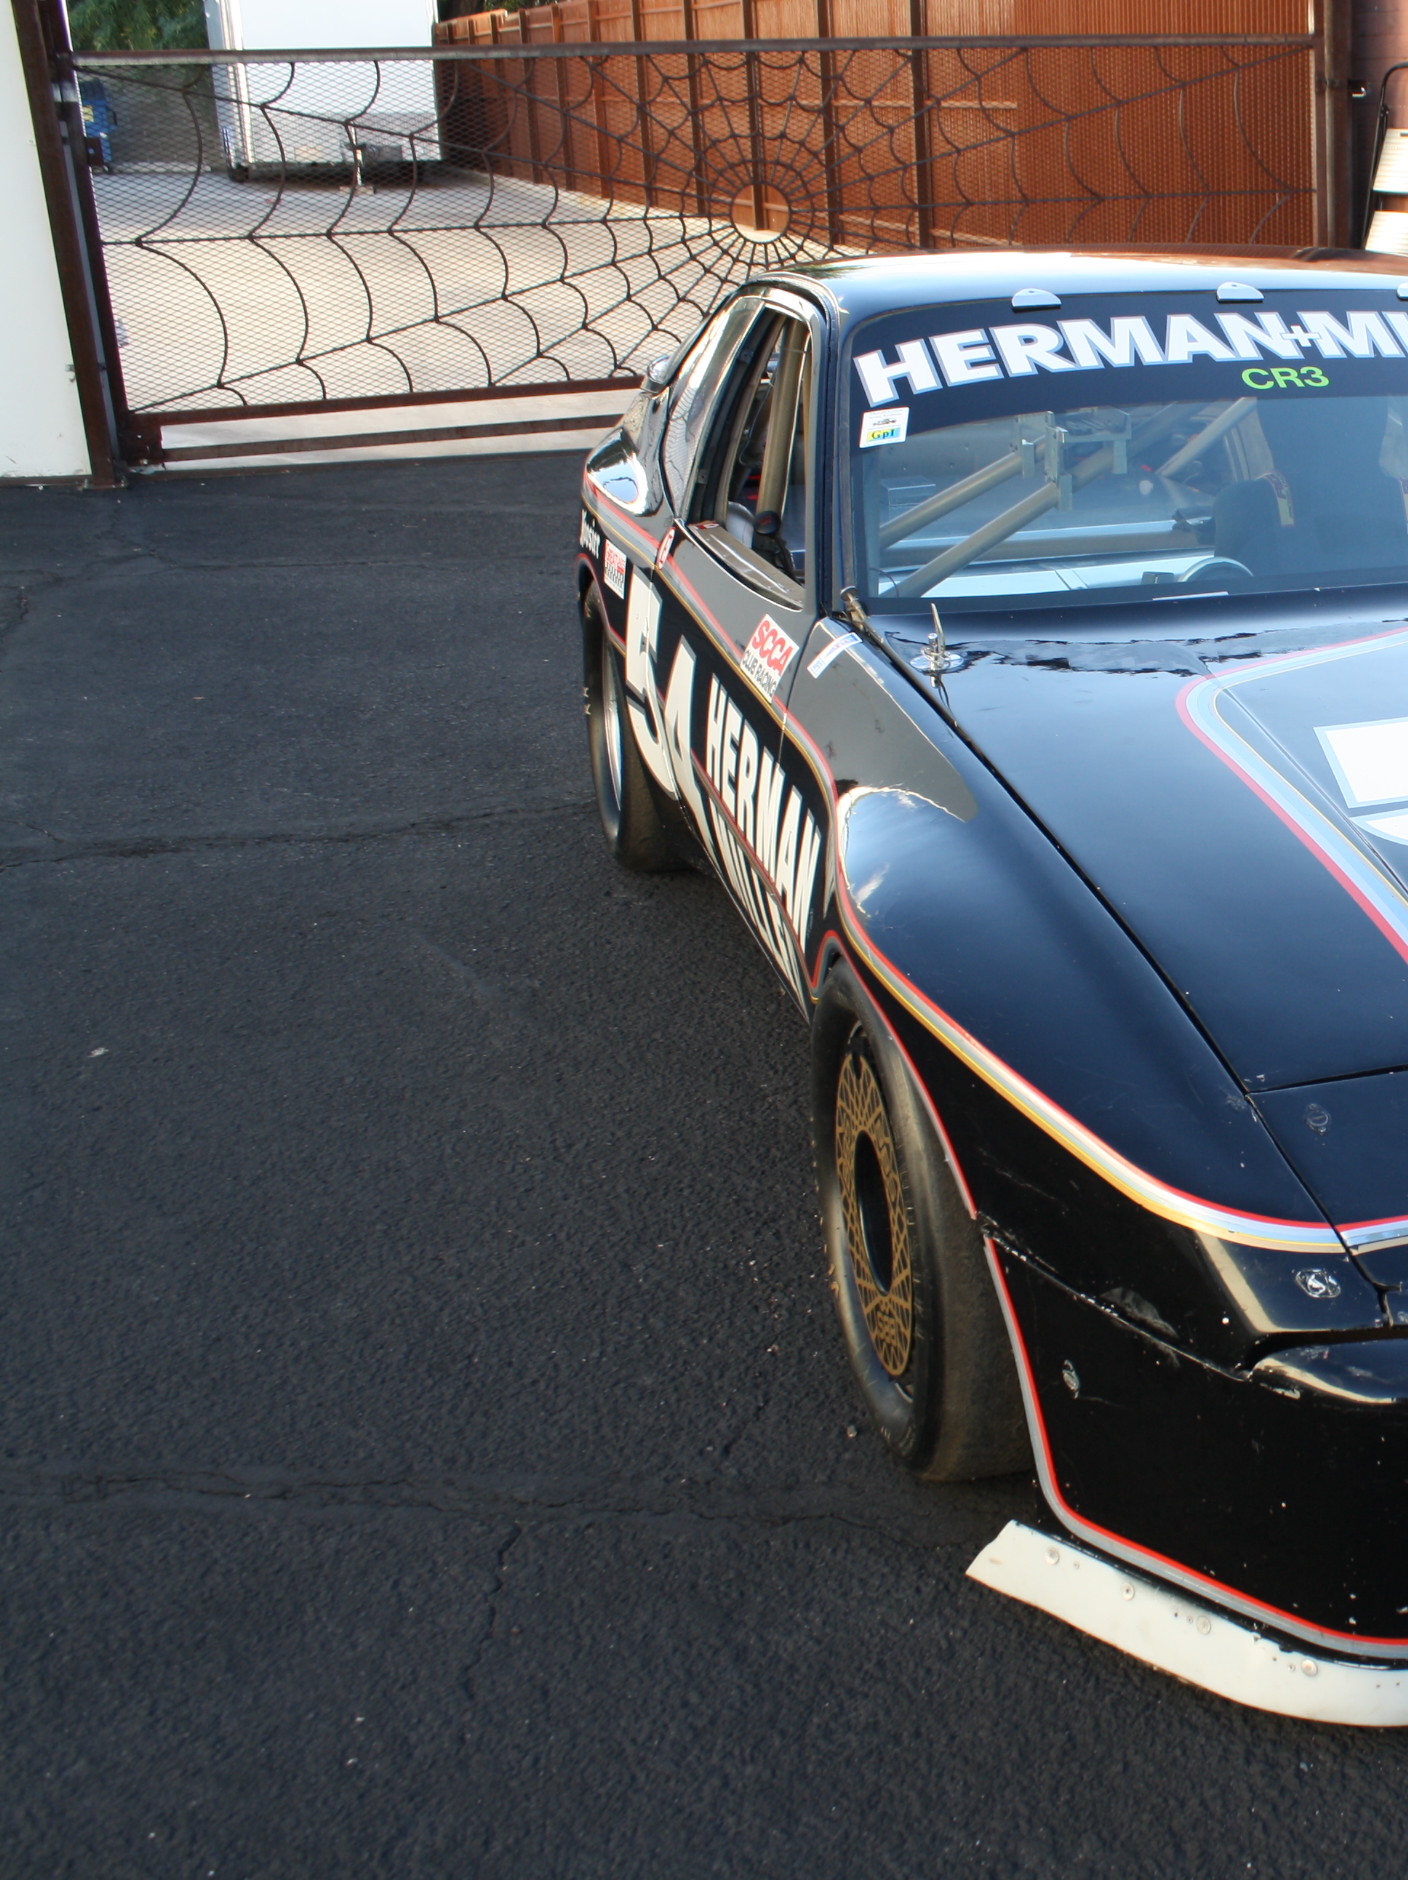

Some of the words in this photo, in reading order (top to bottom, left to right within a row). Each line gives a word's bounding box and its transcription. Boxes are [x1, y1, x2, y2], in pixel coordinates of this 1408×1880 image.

[1241, 366, 1330, 390] CR3
[752, 620, 794, 677] SCCA
[705, 672, 821, 955] HERMAN
